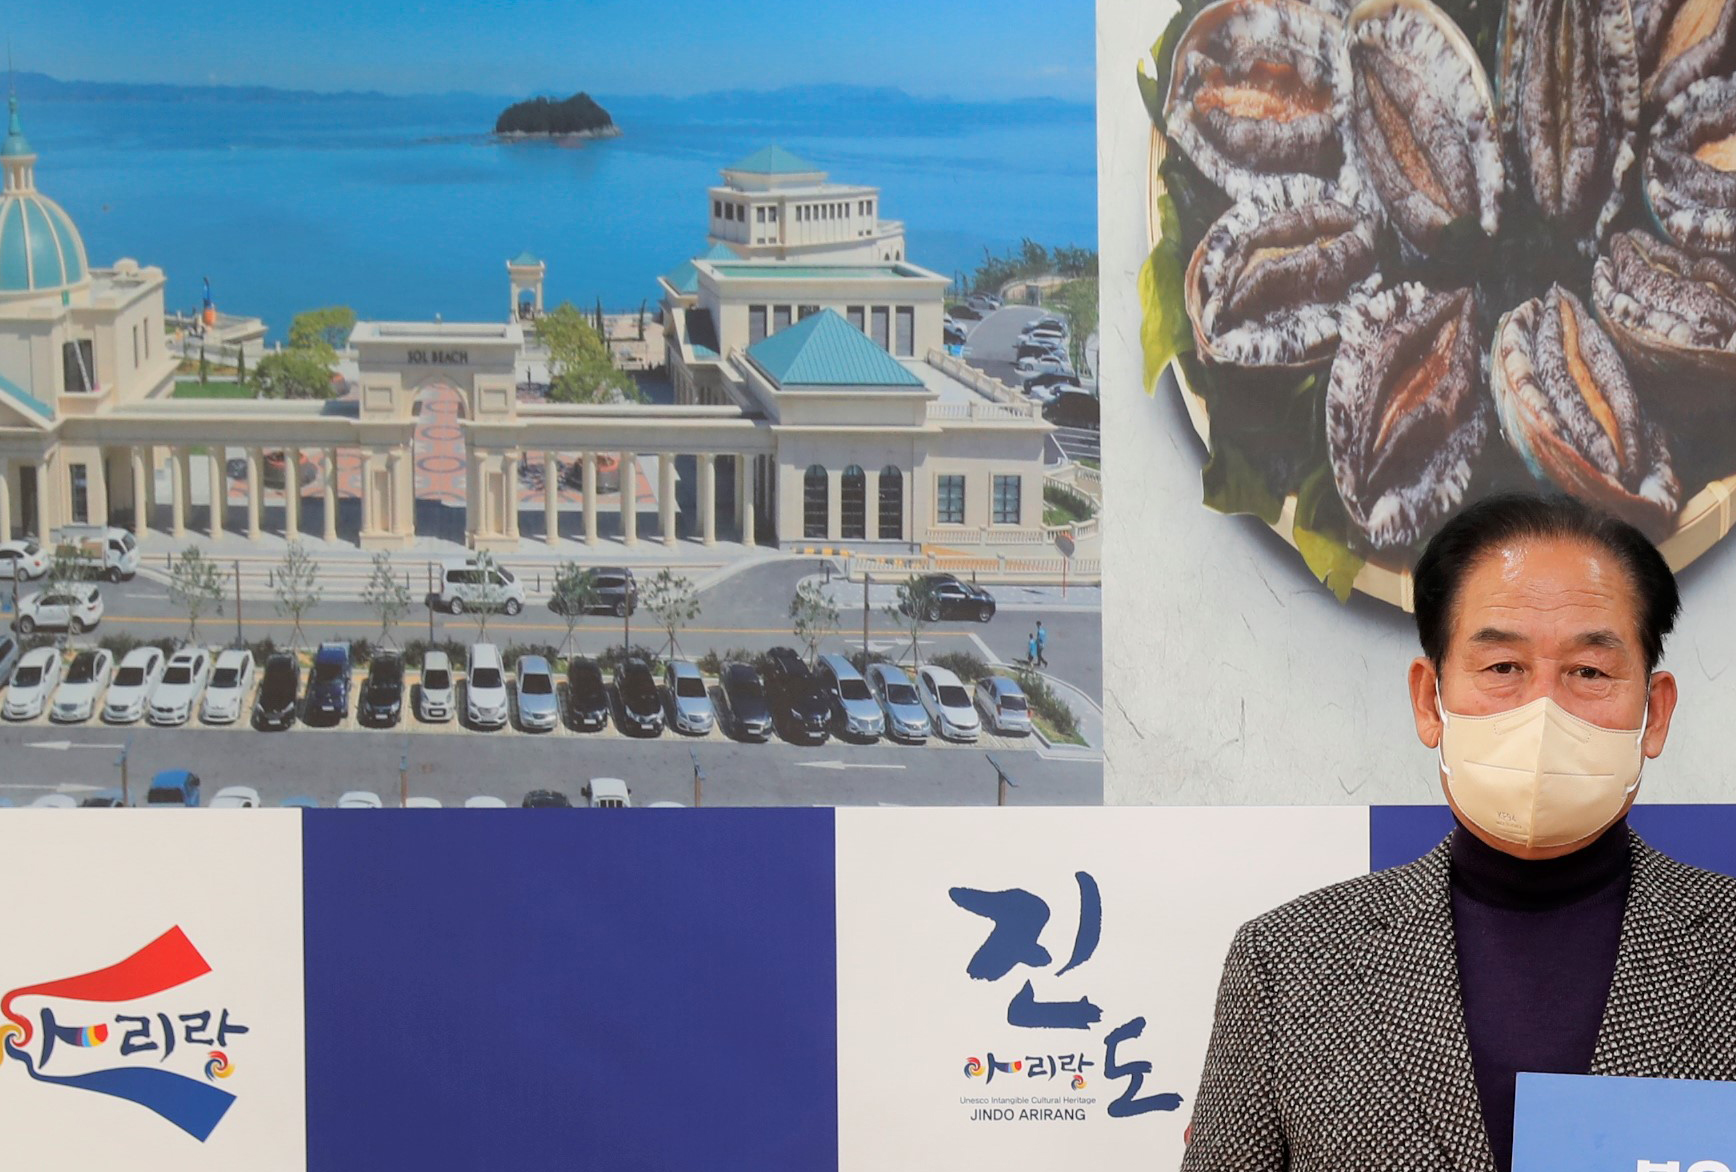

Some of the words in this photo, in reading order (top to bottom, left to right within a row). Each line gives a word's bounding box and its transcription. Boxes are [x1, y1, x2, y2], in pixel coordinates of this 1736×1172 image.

[407, 350, 428, 364] SOL
[432, 350, 468, 364] BEACH
[963, 1052, 1095, 1091] 아리랑
[959, 1096, 990, 1105] Unesco
[991, 1096, 1030, 1106] Intangible
[1031, 1096, 1061, 1105] Cultural
[1063, 1096, 1096, 1106] Heritage
[970, 1108, 1014, 1121] JINDO
[1018, 1108, 1086, 1121] ARIRANG
